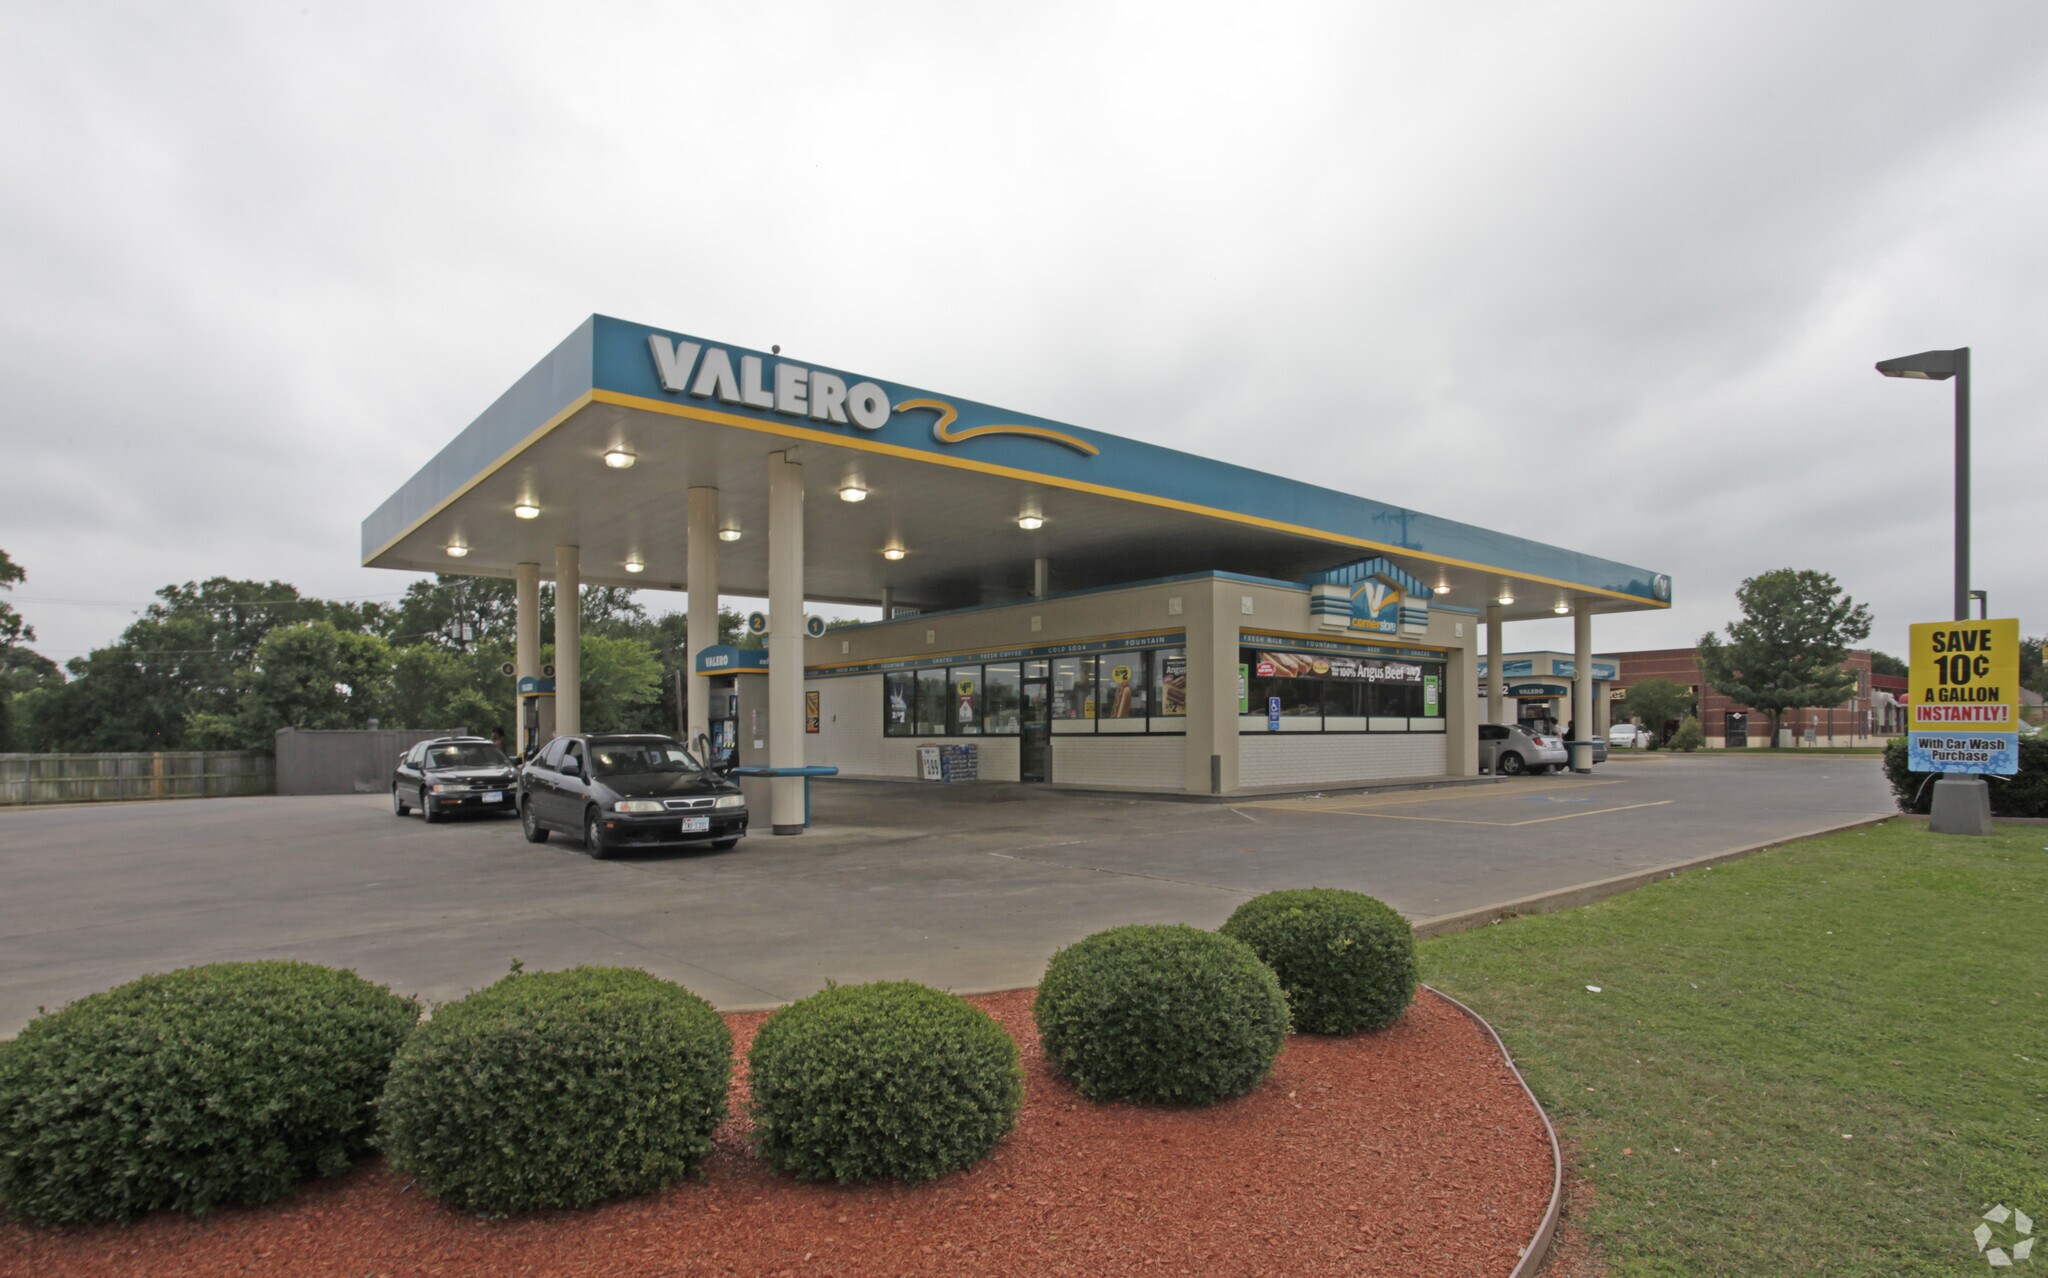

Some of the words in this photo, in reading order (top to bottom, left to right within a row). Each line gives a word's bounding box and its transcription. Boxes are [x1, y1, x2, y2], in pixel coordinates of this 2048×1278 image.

[648, 333, 891, 431] VALERO
[753, 617, 762, 629] 2
[812, 622, 818, 632] 1
[1125, 637, 1165, 647] FOUNTAIN
[1243, 635, 1265, 643] FRESH
[1306, 641, 1338, 649] FOUNTAIN
[1932, 629, 1992, 653] SAVE
[1000, 650, 1022, 658] COFFEE
[705, 655, 728, 667] VALERO
[1357, 664, 1384, 682] Angus
[1385, 666, 1404, 680] Beef
[1924, 688, 1935, 703] A
[1938, 687, 2000, 702] GALLON
[1916, 706, 2008, 721] INSTANTLY!
[1918, 738, 1944, 749] With
[1946, 738, 1966, 750] Car
[1969, 739, 2005, 750] Wash
[1931, 750, 1989, 761] Purchase
